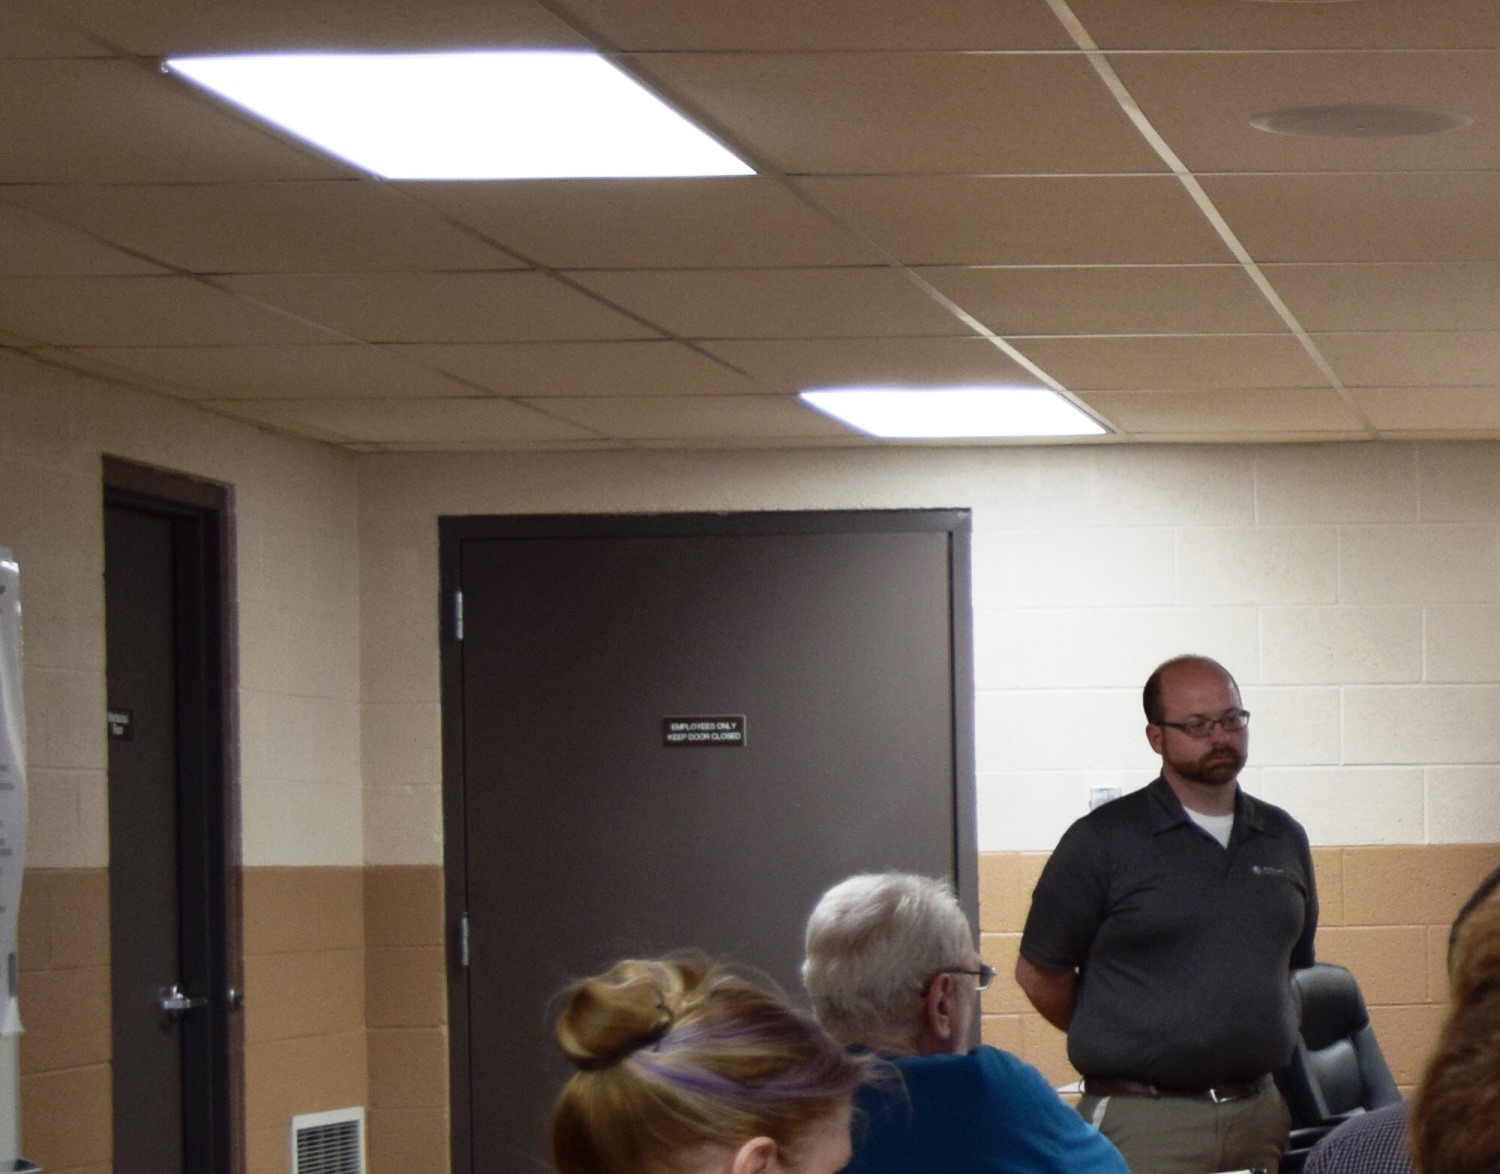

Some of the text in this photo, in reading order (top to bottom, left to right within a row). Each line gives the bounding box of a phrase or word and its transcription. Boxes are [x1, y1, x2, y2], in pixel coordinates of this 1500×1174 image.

[671, 722, 737, 731] EMPLOYEES ONLY
[667, 732, 741, 741] KEEP DOOR CLOSED
